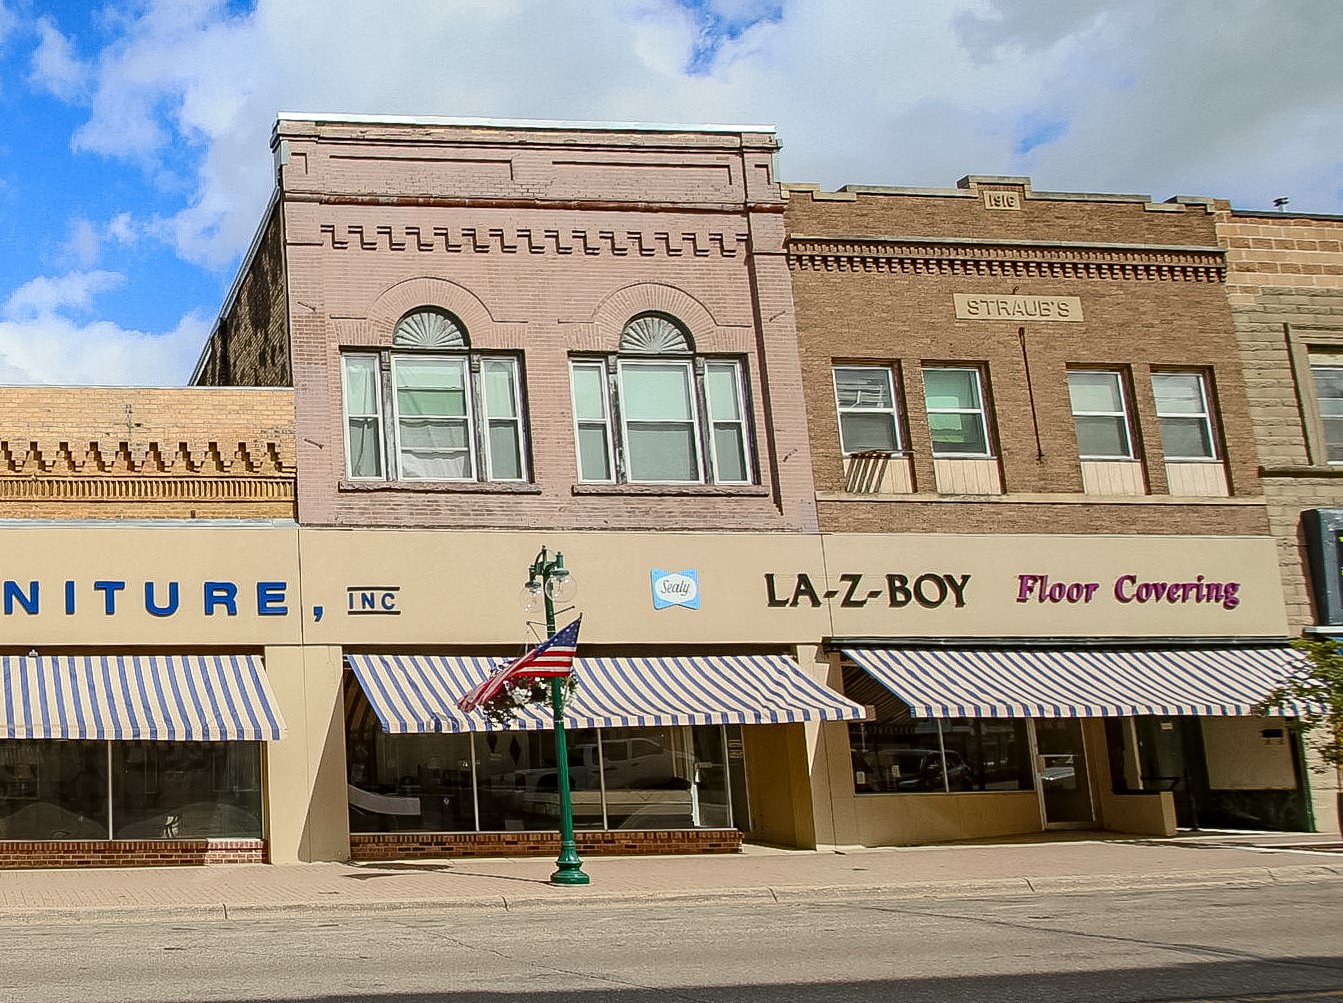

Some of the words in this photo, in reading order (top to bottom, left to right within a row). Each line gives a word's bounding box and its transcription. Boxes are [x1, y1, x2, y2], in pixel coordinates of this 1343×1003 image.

[966, 299, 1071, 318] STRAUB'S
[660, 579, 691, 597] Sealy
[764, 573, 972, 609] LA-Z-BOY
[1015, 573, 1100, 605] Floor
[1114, 574, 1242, 610] Covering
[348, 592, 396, 610] INC
